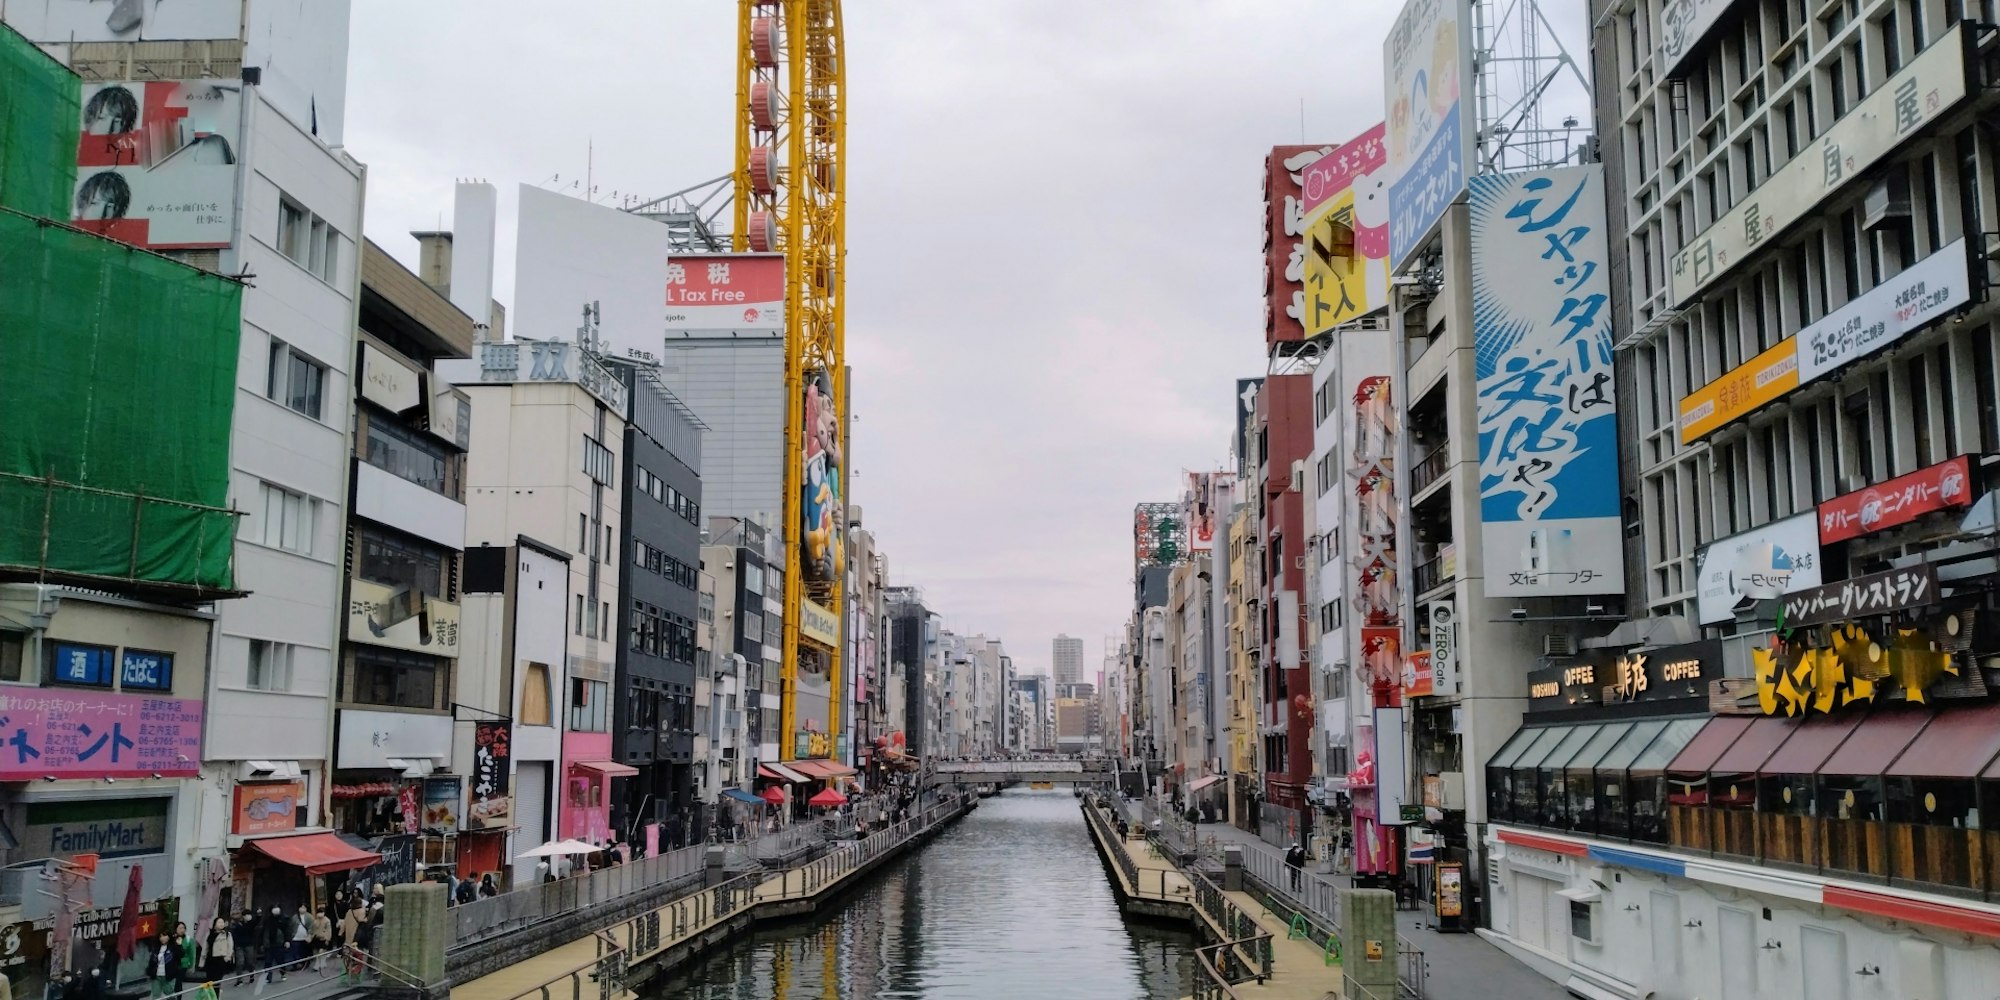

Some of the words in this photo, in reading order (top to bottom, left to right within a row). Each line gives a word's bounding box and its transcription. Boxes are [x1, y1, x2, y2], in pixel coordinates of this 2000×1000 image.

[1393, 150, 1458, 258] ガルフネット
[1675, 253, 1688, 276] 4F
[680, 289, 706, 301] Tax
[711, 288, 745, 301] Free
[1784, 572, 1928, 621] ハンバーグレストラン
[1435, 625, 1448, 660] ZERO
[69, 651, 87, 679] 酒
[123, 657, 158, 684] たばこ
[1663, 659, 1700, 682] COFFEE
[1531, 682, 1559, 698] HOSHINO
[51, 821, 145, 851] FamilyMart
